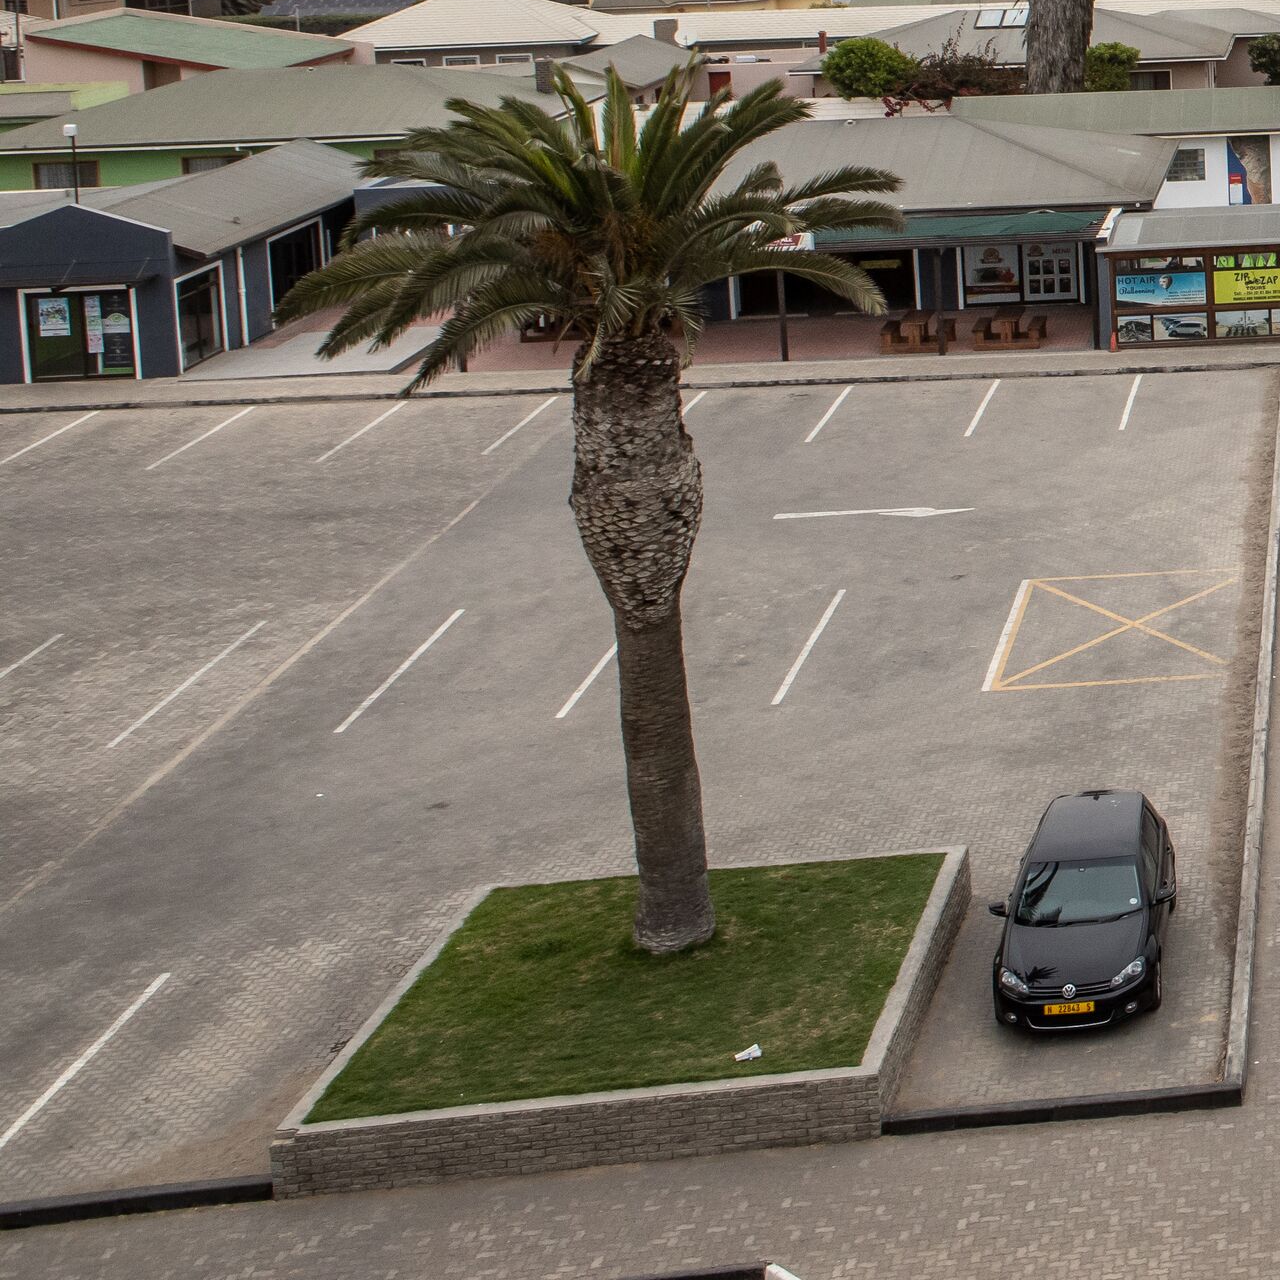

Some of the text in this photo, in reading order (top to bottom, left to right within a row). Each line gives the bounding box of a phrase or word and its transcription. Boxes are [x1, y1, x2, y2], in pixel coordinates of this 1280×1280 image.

[1140, 276, 1156, 284] AIR
[1234, 273, 1278, 284] ZIP ZAP
